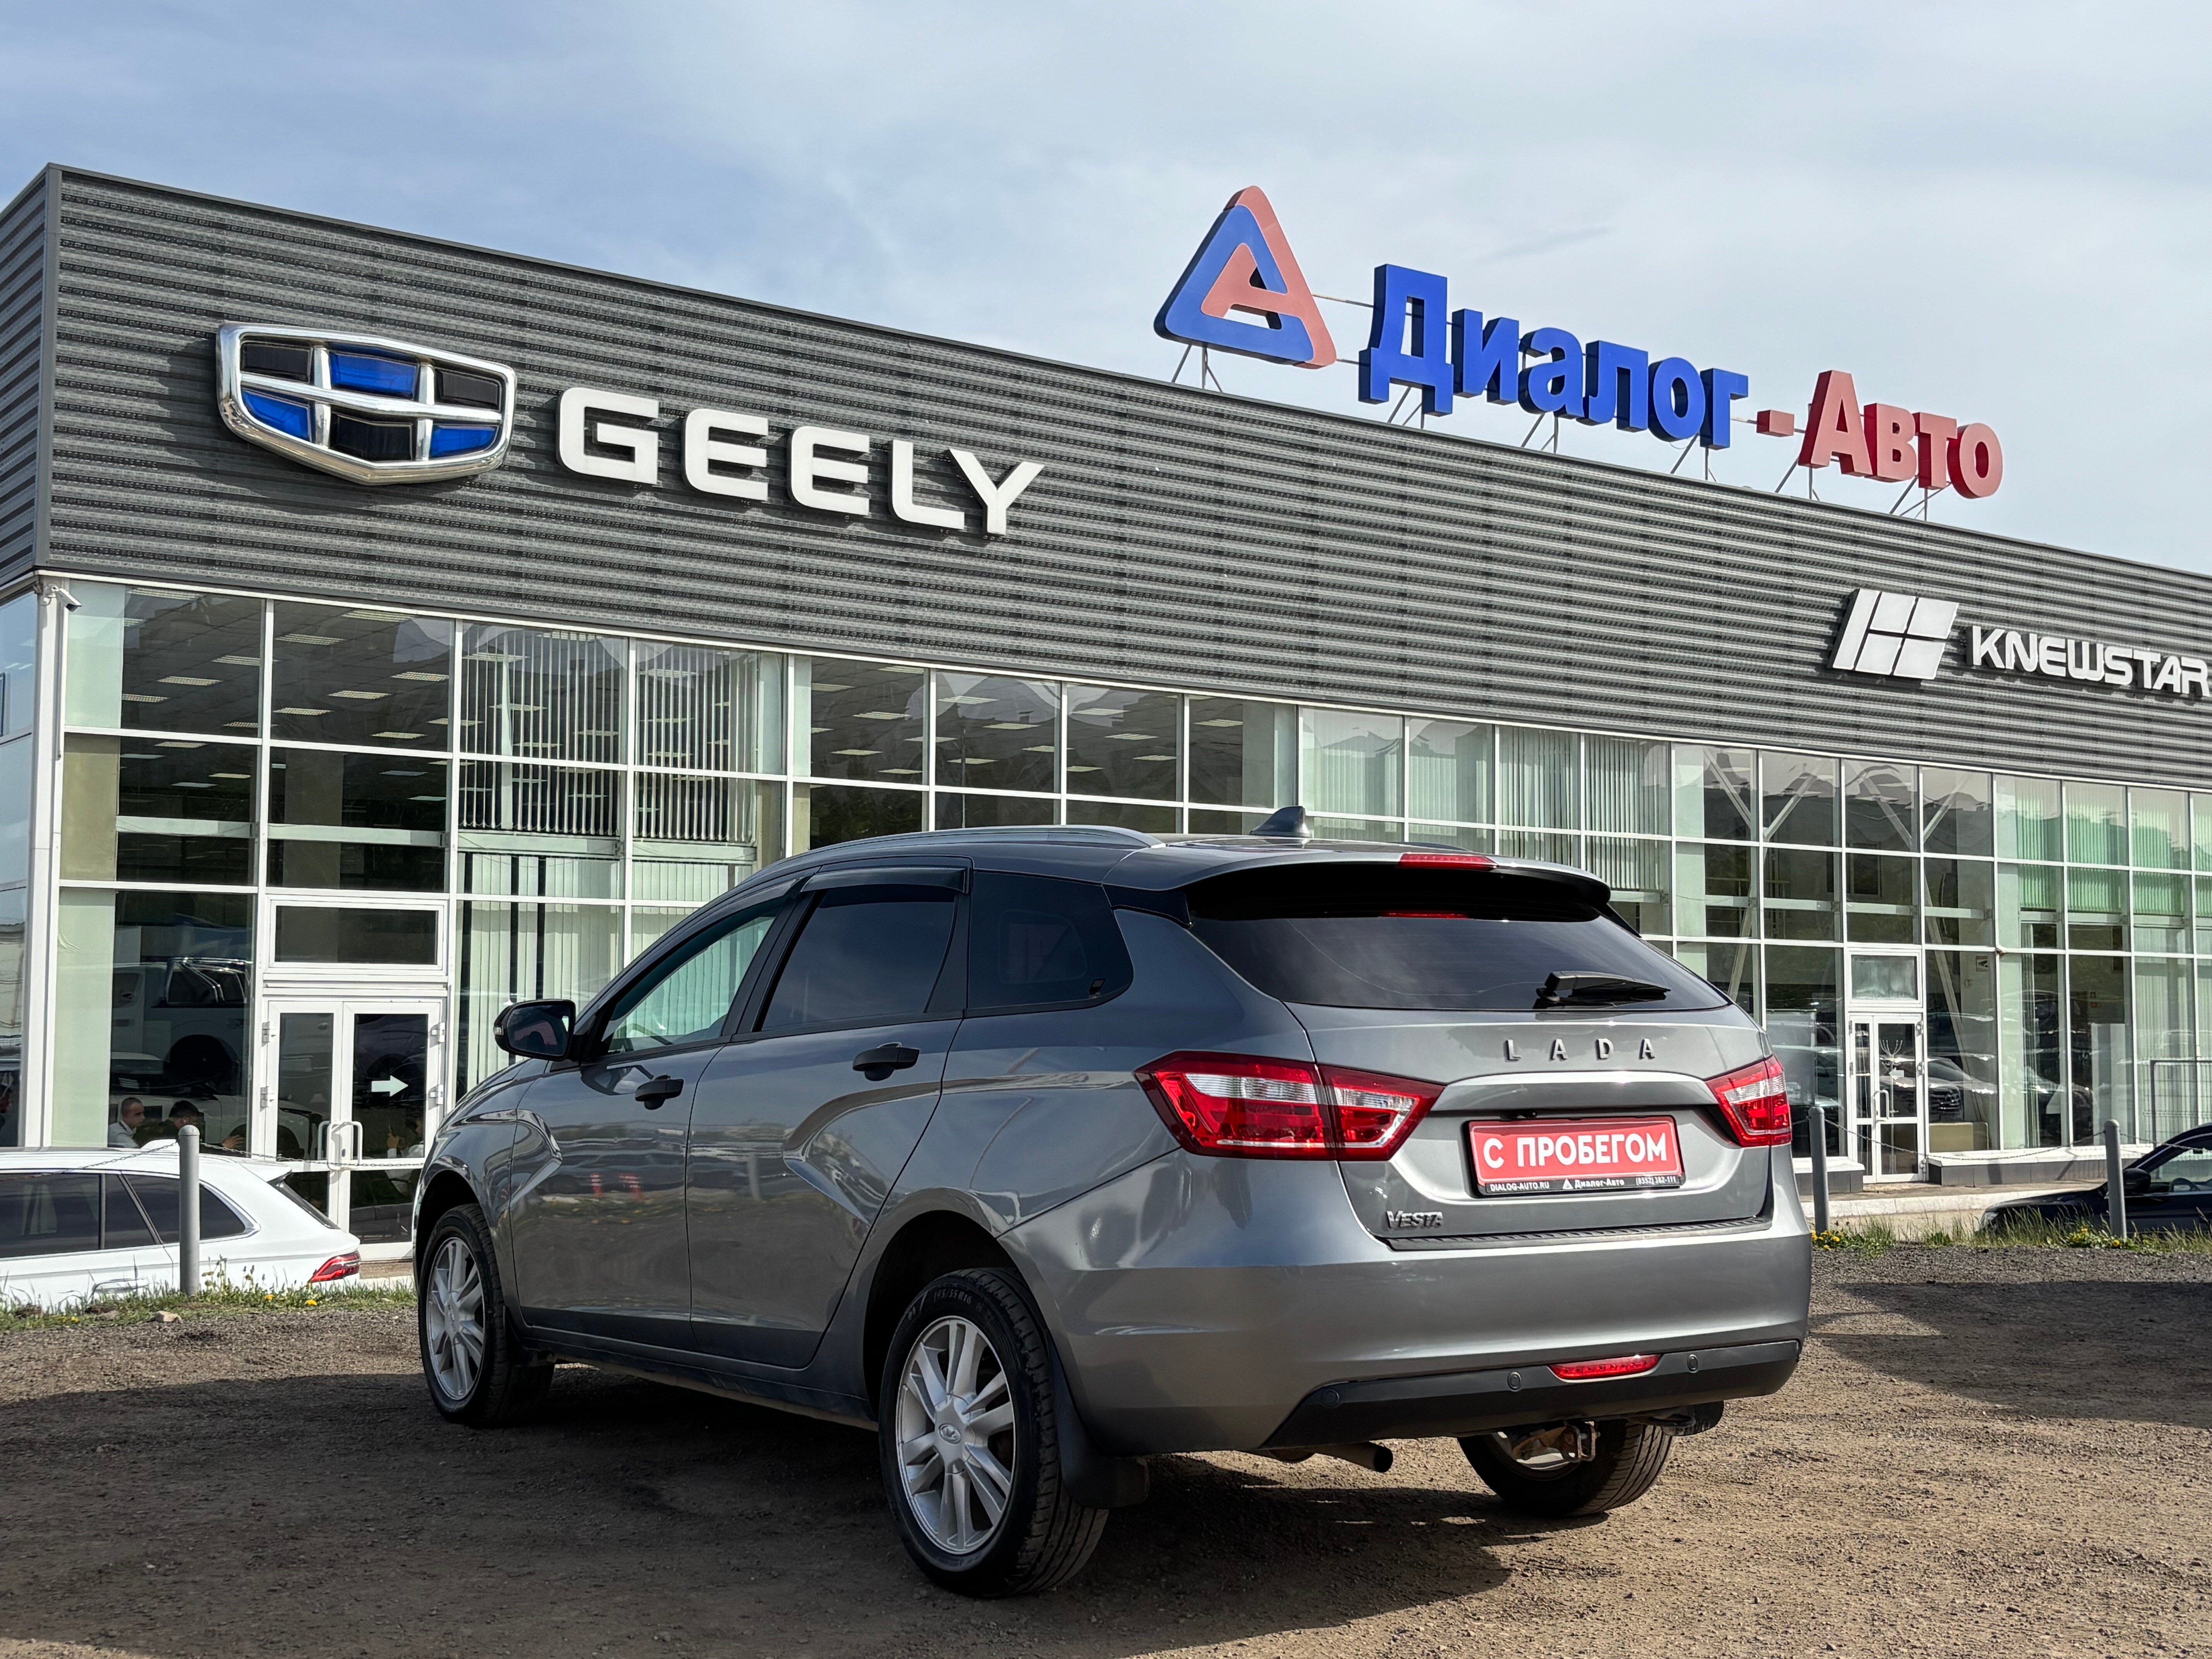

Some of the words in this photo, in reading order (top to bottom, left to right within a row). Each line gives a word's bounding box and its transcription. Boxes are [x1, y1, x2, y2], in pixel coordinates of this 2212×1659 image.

[556, 387, 1045, 534] GEELY
[1970, 625, 2210, 697] KNEWSTAR
[1503, 1038, 1656, 1062] LADA
[1483, 1138, 1504, 1169] С
[1517, 1132, 1667, 1167] ПРОБЕГОМ
[1490, 1181, 1549, 1192] DIALOG-AUTO.RU
[1575, 1178, 1625, 1189] Диалог-Авто
[1386, 1210, 1443, 1228] VESTA
